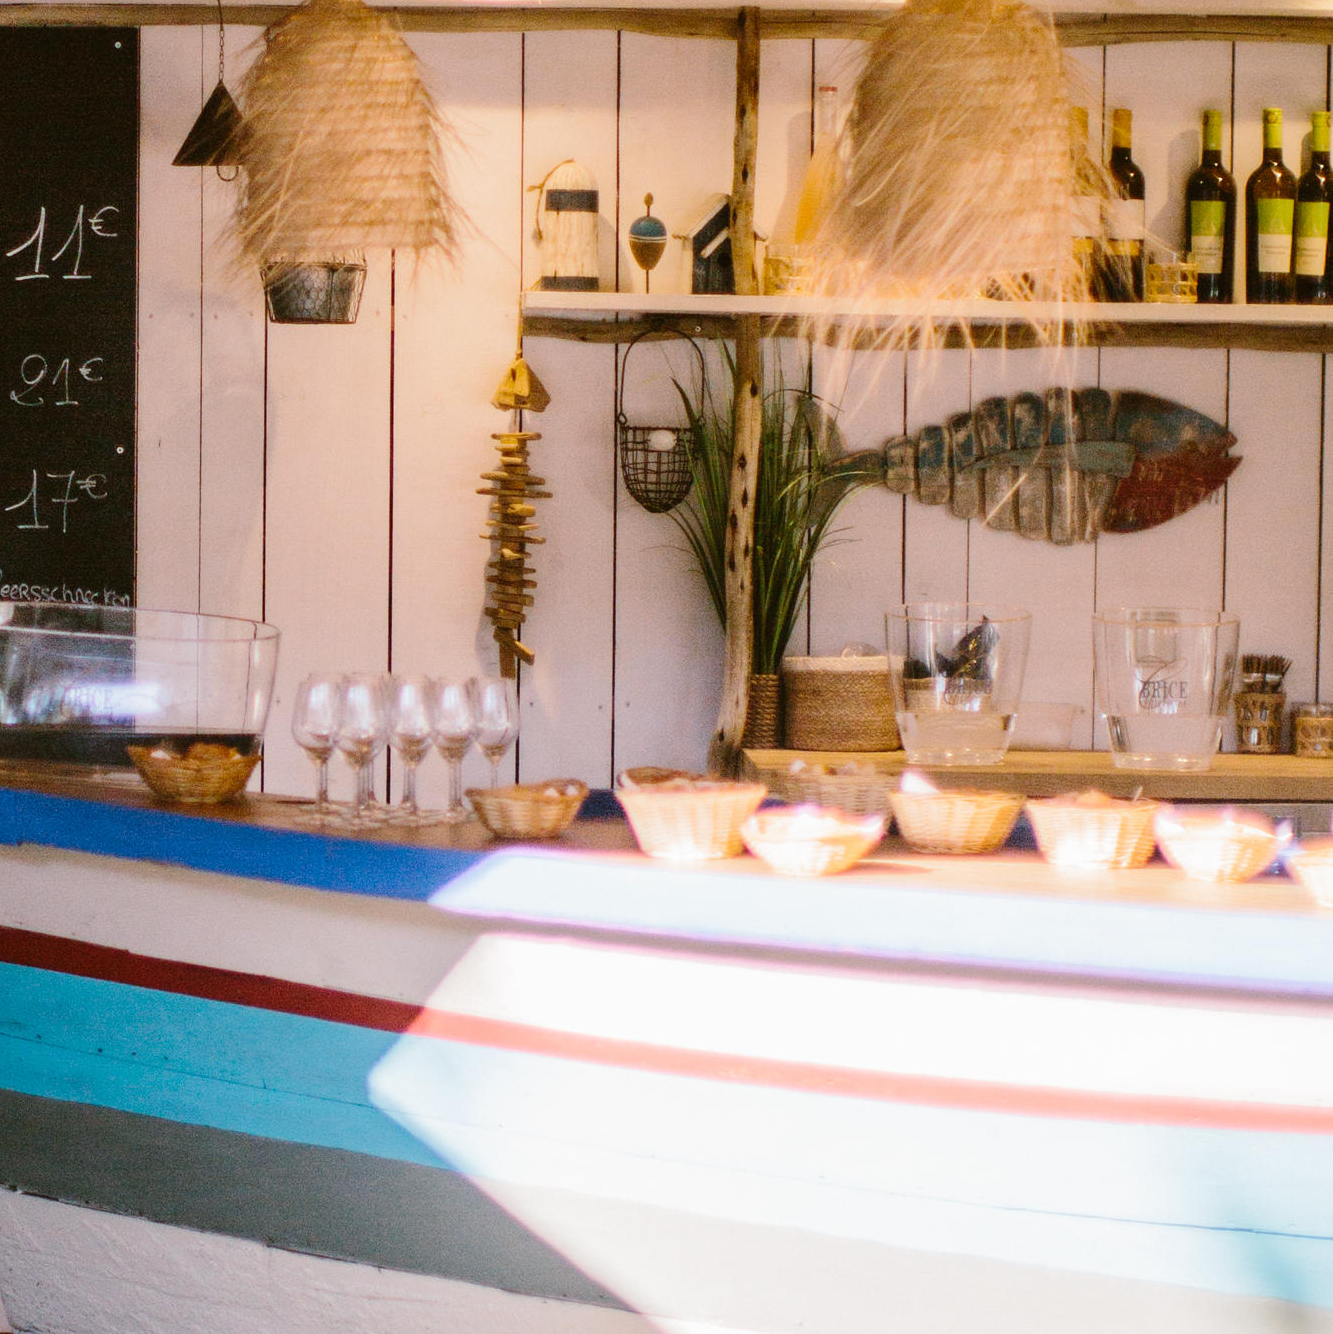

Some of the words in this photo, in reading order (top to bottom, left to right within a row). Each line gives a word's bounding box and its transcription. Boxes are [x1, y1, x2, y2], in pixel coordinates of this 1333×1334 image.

[5, 204, 120, 281] 11€
[9, 353, 104, 407] 21€
[4, 468, 108, 534] 17€
